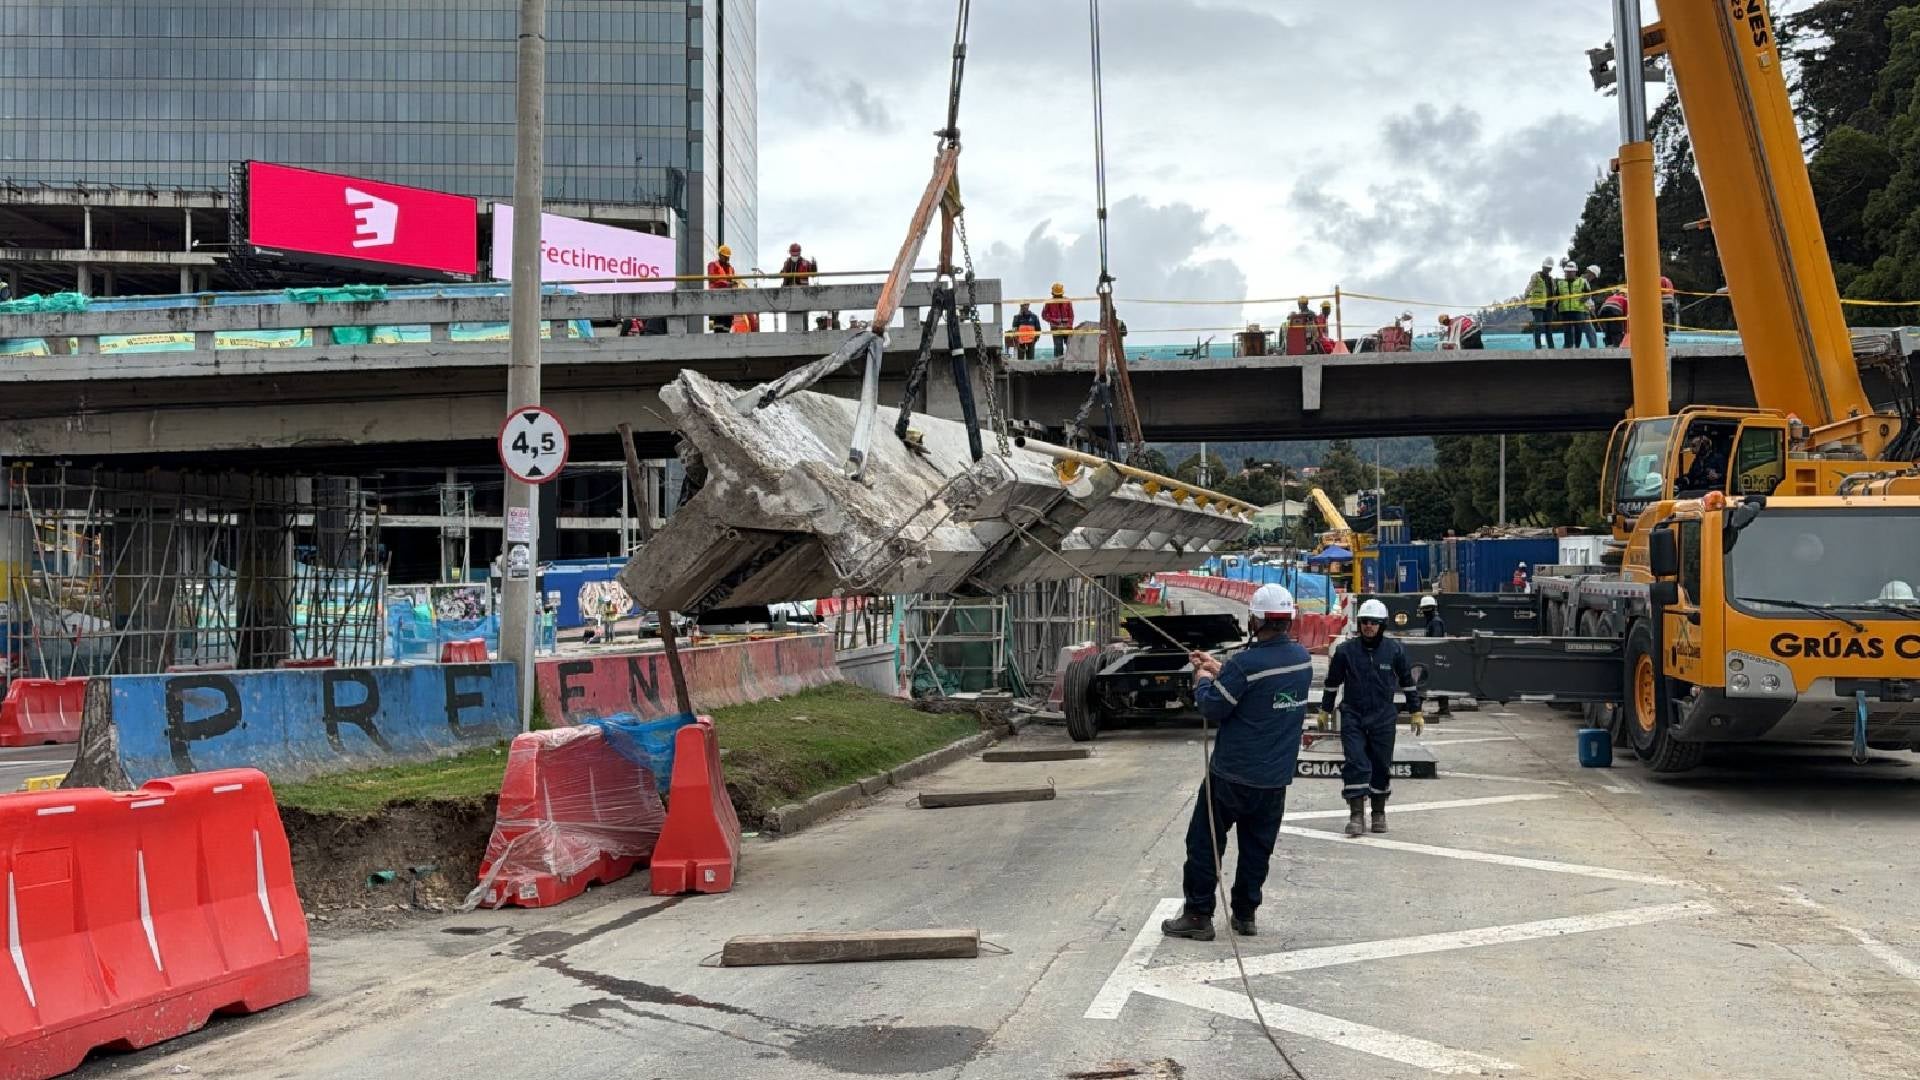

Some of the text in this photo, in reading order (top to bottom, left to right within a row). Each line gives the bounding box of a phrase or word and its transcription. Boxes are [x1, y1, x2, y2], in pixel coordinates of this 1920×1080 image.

[512, 431, 556, 459] 4,5
[1770, 631, 1884, 658] GRÚAS
[1297, 761, 1344, 775] GRÚA
